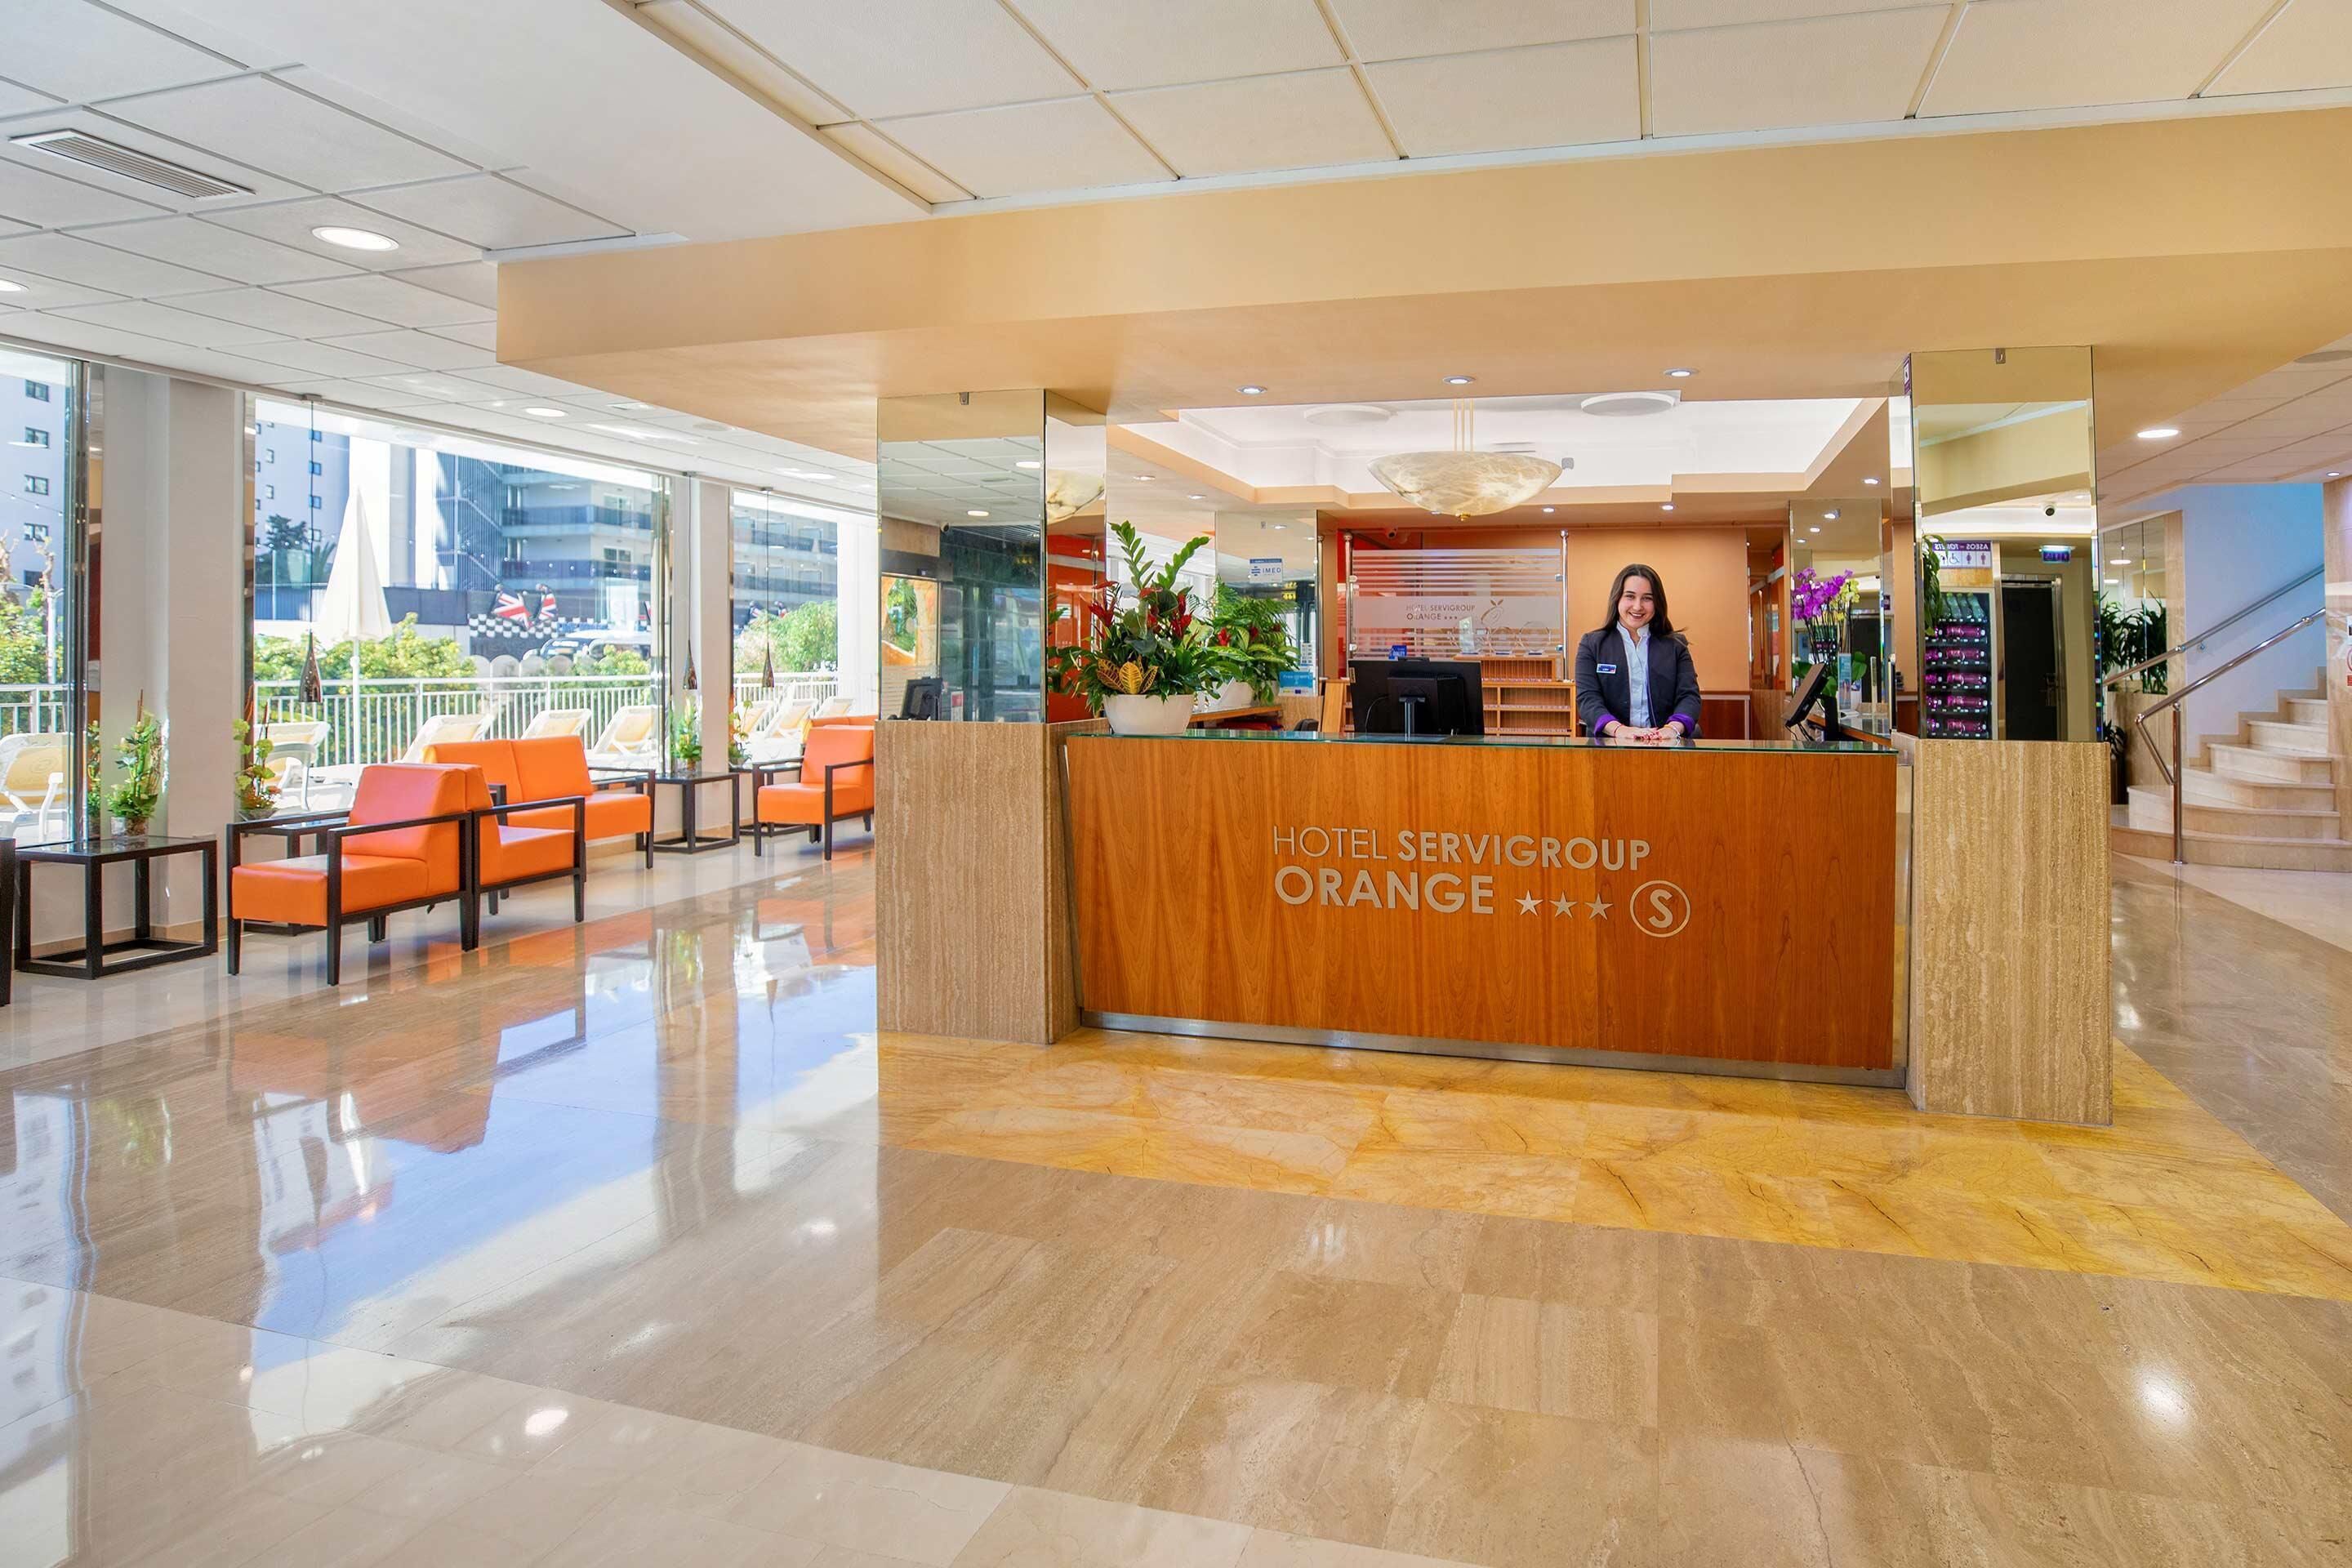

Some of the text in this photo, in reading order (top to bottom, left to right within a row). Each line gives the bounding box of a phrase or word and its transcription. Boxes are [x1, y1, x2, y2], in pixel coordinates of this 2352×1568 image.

[1273, 825, 1650, 871] HOTEL SERVIGROUP
[1274, 866, 1494, 915] ORANGE
[1648, 889, 1673, 929] S
